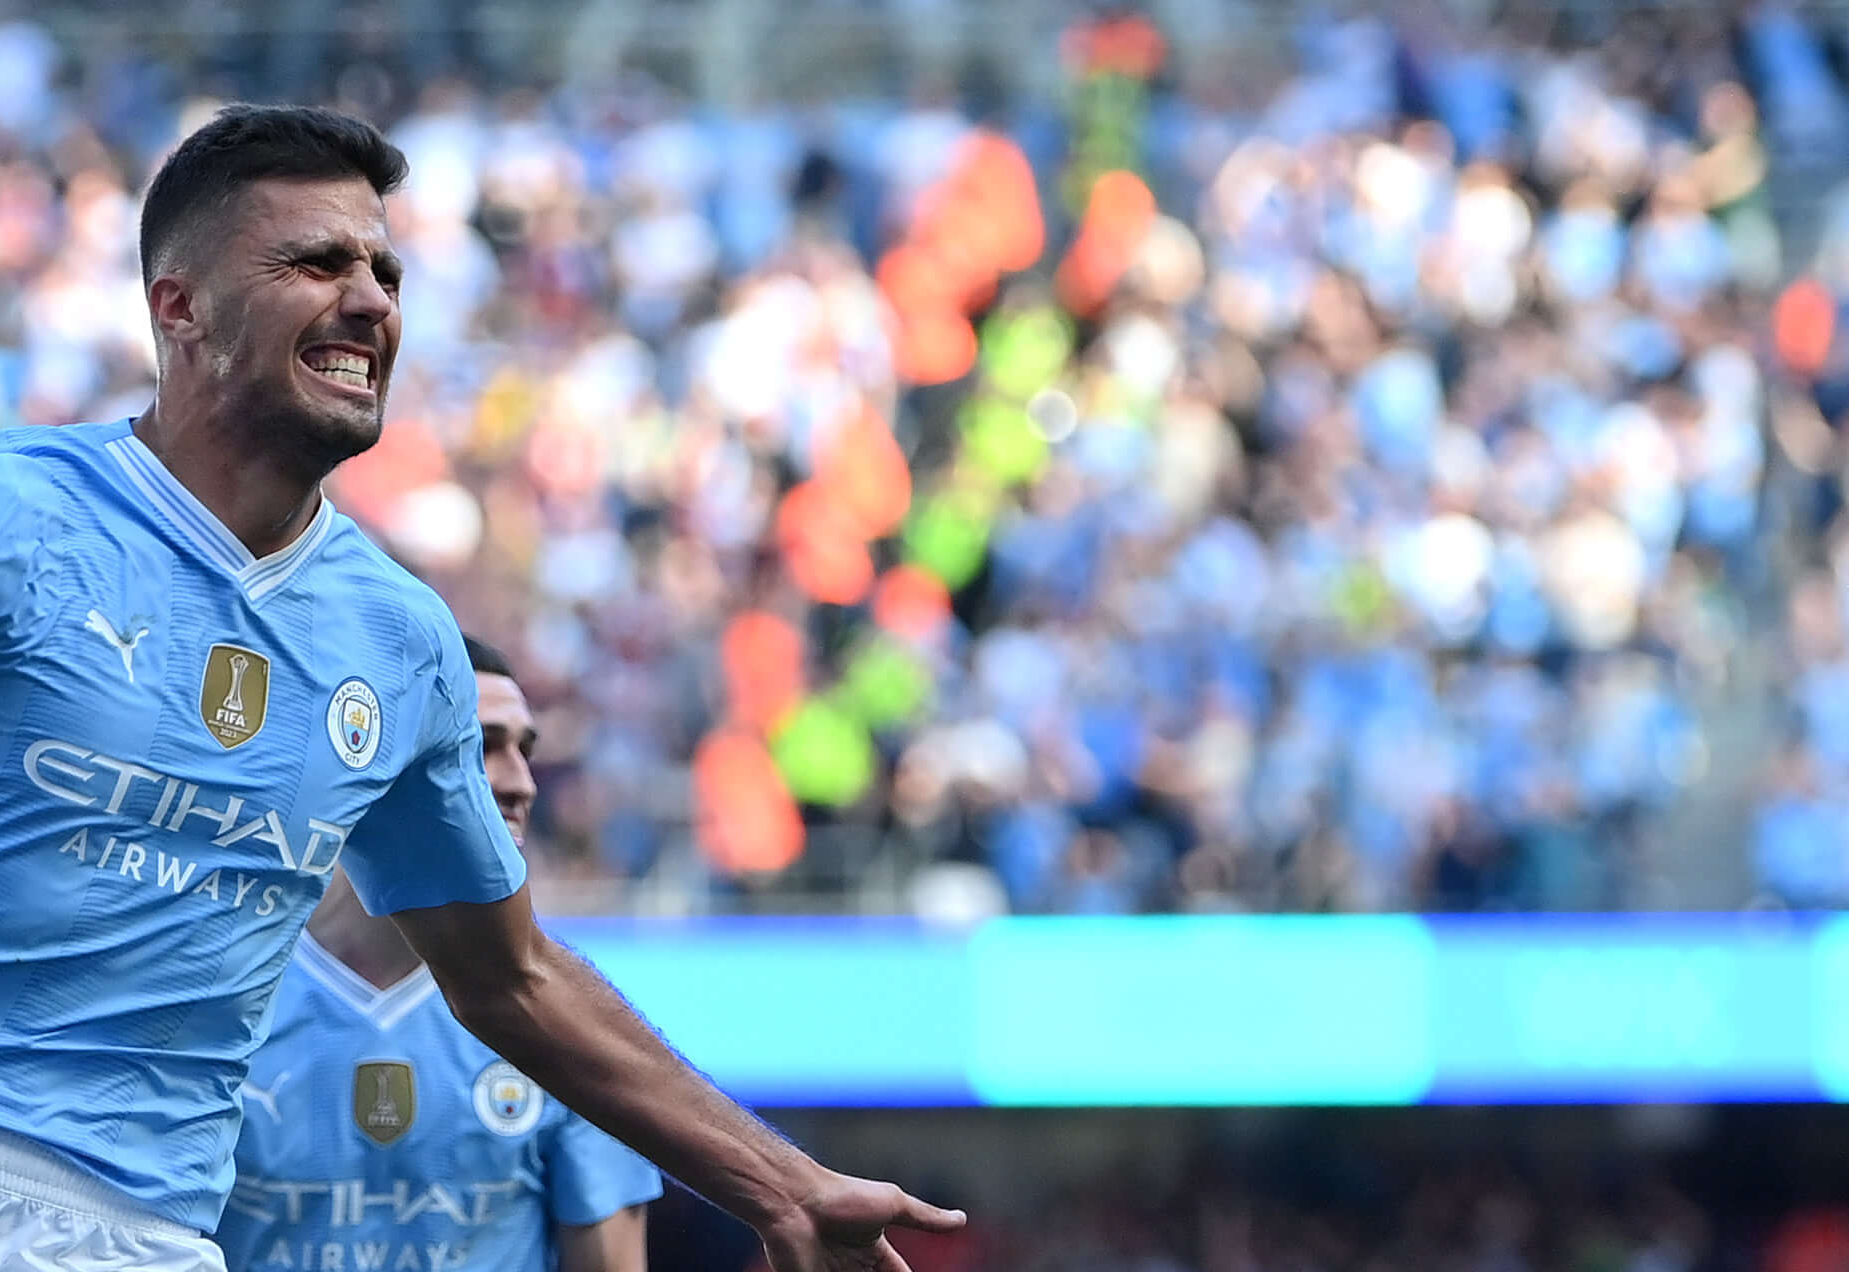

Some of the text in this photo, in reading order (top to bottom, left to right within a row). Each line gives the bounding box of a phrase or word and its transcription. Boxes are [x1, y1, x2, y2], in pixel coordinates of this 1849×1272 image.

[216, 708, 246, 728] FIFA
[335, 683, 379, 721] MANCHESTER
[345, 752, 360, 766] CITY
[23, 740, 348, 875] ETIHAD
[59, 826, 283, 917] AIRWAYS
